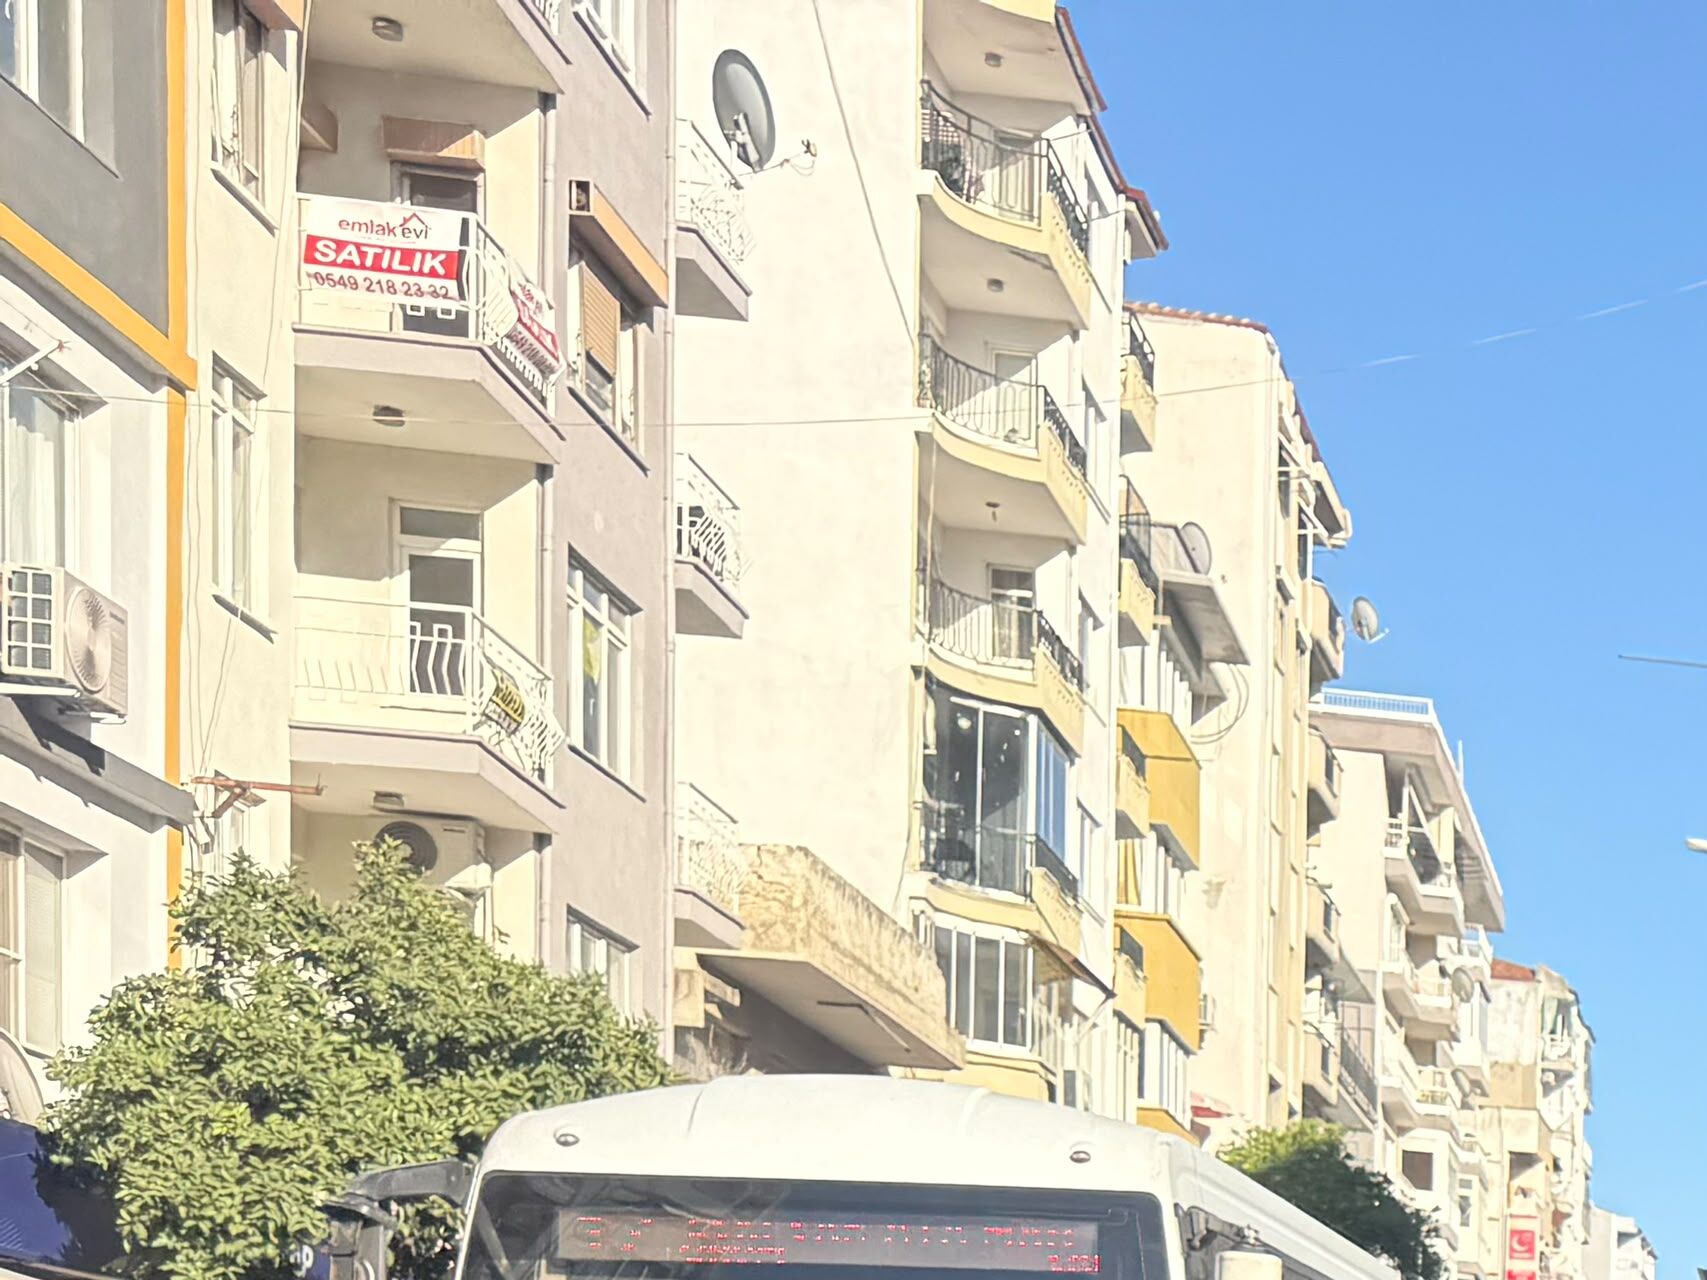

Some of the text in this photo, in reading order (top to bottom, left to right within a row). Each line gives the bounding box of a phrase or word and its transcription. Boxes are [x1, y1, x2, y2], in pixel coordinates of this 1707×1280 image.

[338, 217, 430, 240] emlak evi
[313, 239, 447, 276] SATILIK
[314, 271, 359, 291] 0549
[365, 278, 398, 296] 218
